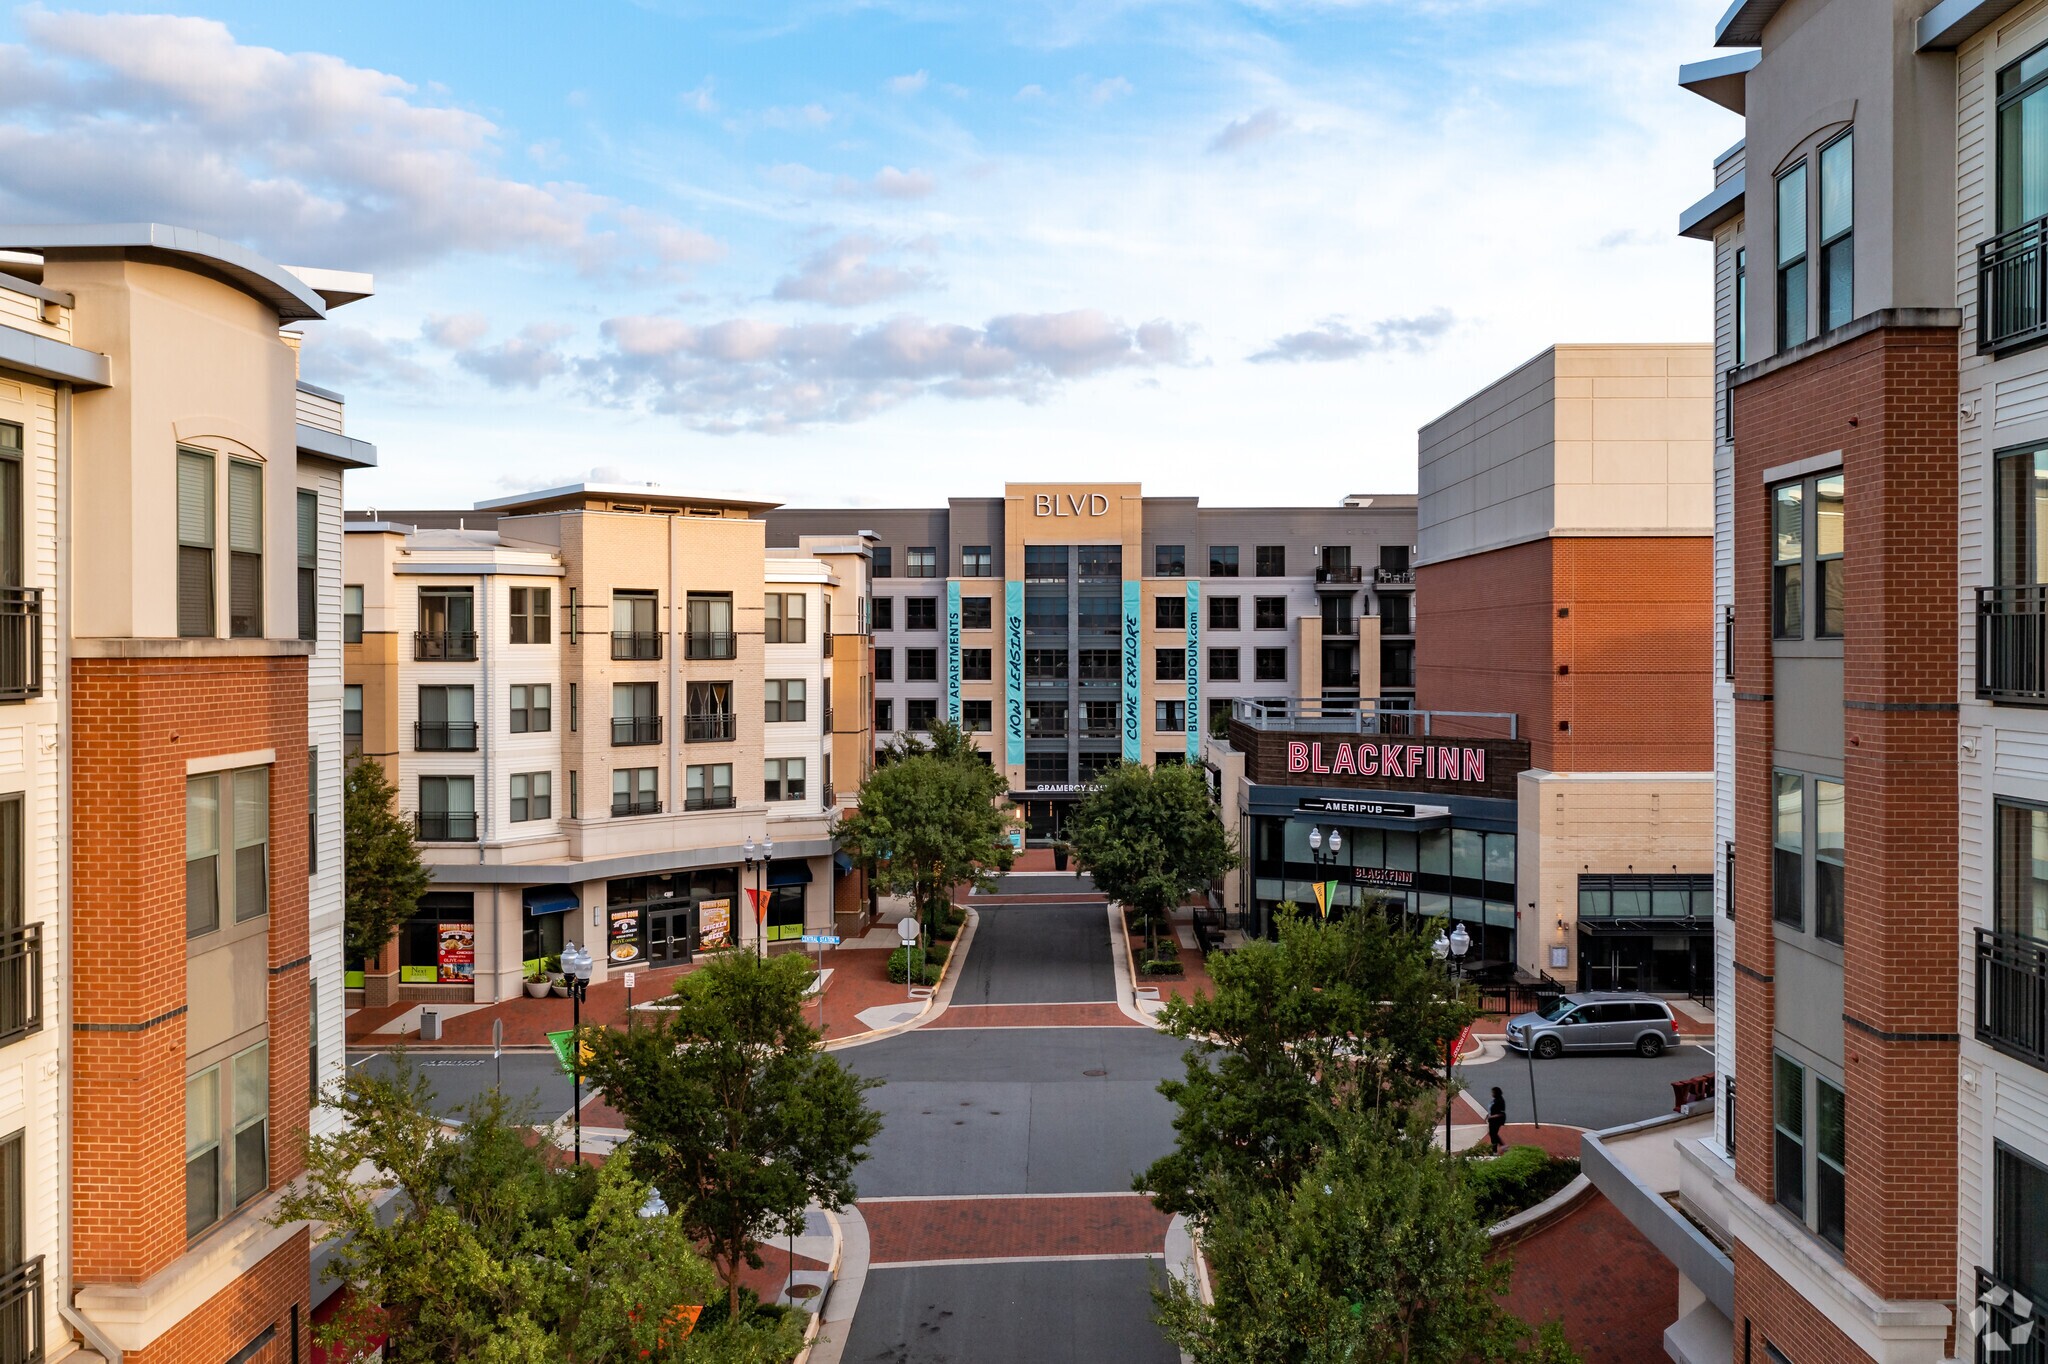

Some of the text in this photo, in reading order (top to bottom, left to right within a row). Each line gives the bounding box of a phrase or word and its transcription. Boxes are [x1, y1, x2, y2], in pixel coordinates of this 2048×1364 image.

[1035, 493, 1110, 516] BLVD
[949, 612, 960, 698] APARTMENTS
[1188, 611, 1198, 732] BLVDLOUDOUN.com
[1009, 616, 1022, 738] NOW LEASING
[1125, 613, 1139, 740] COME EXPLORE
[1288, 741, 1485, 783] BLACKFINN
[1037, 784, 1087, 792] GRAMERCY
[1325, 802, 1383, 814] AMERIPUB
[1355, 867, 1413, 883] BLACKFINN
